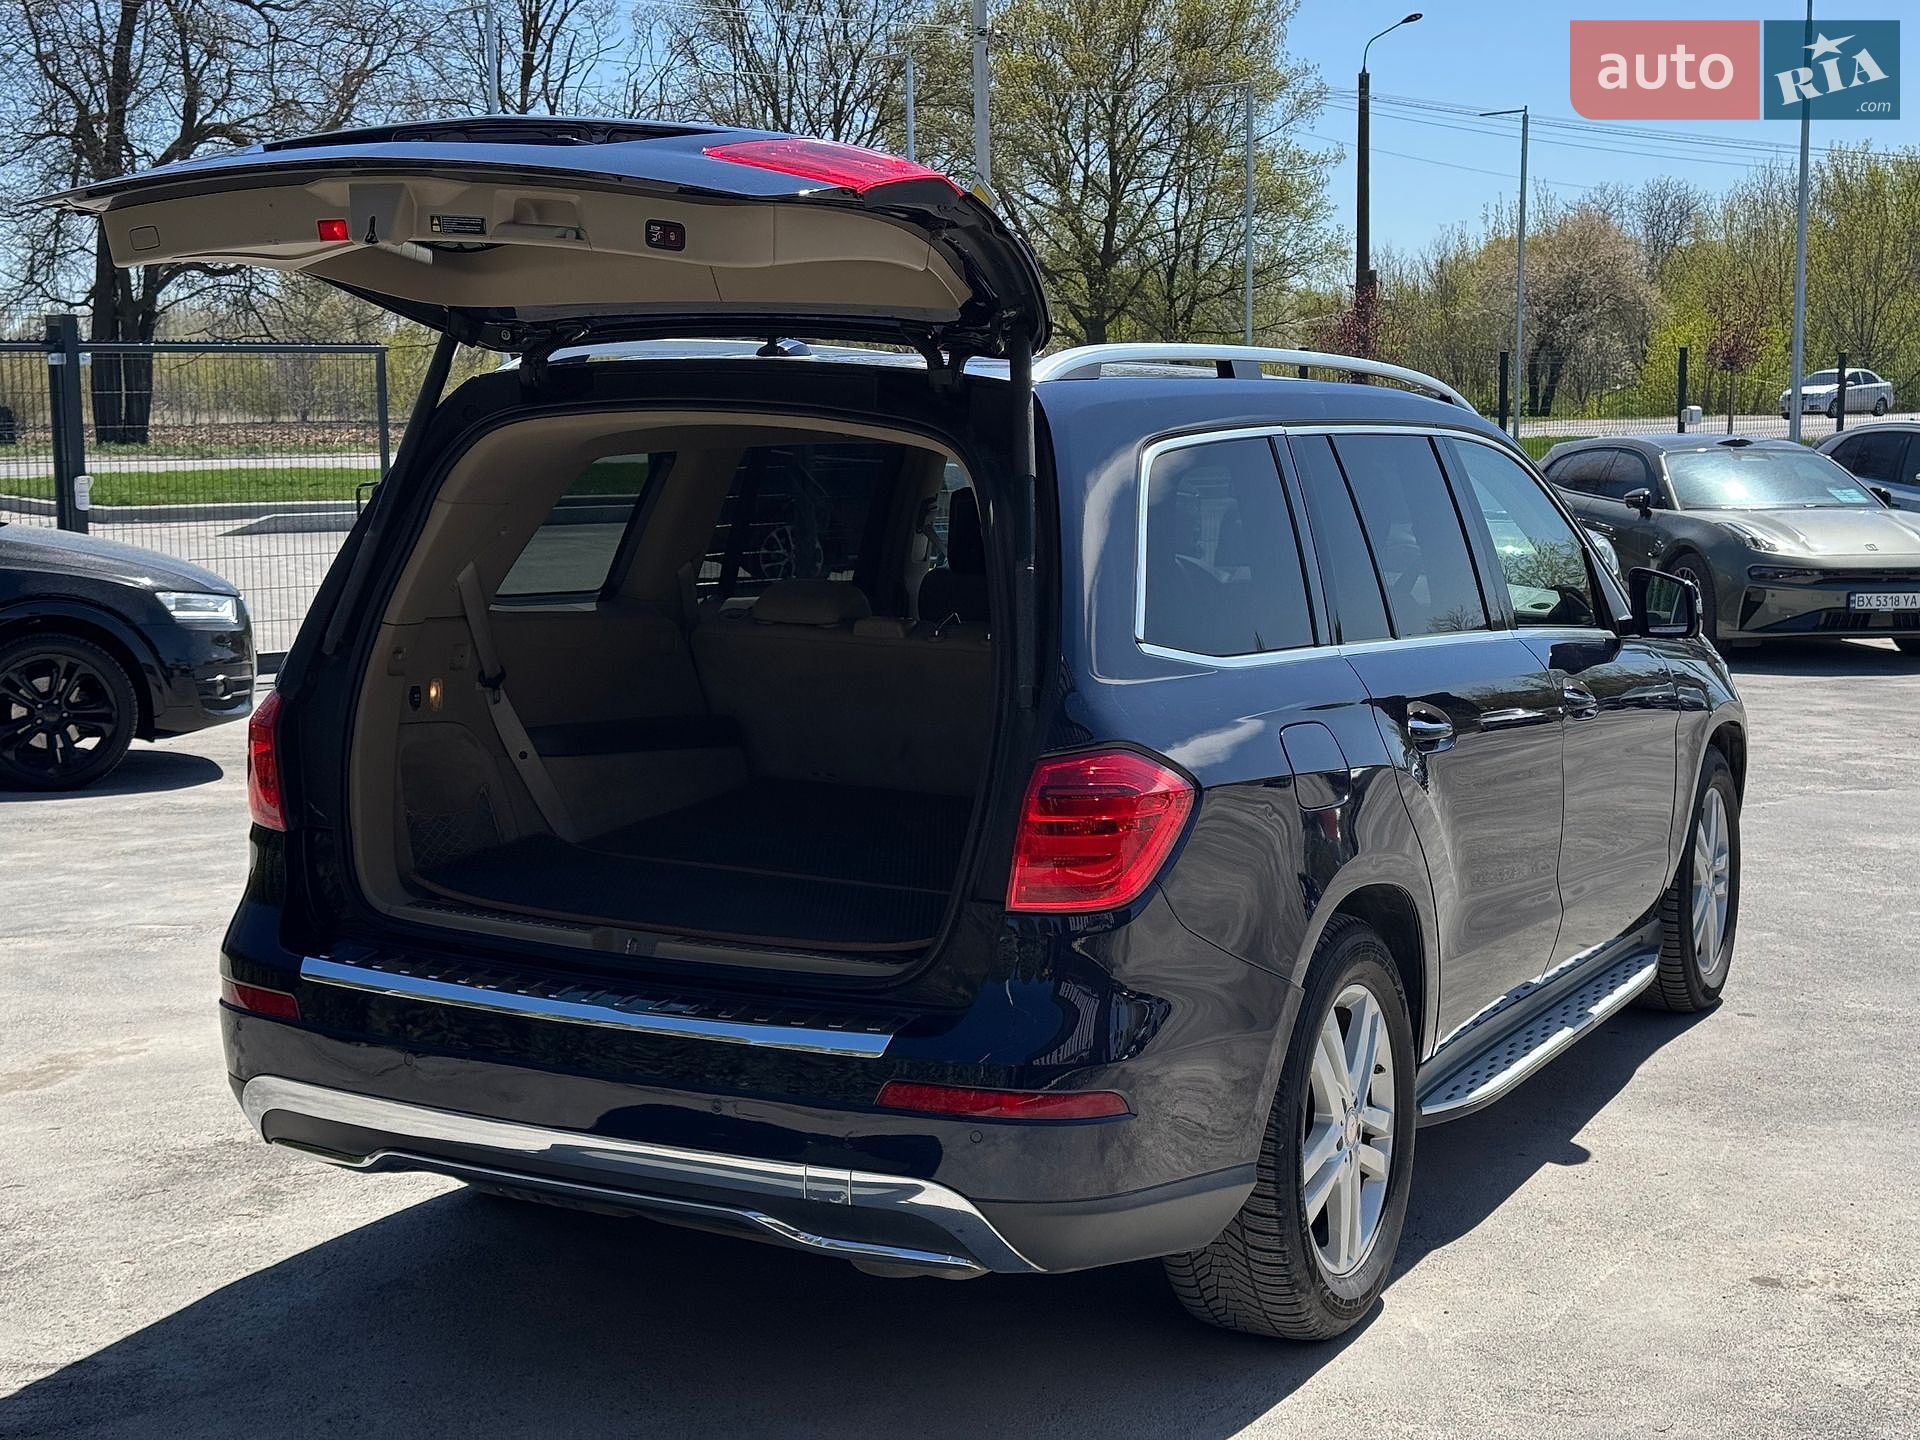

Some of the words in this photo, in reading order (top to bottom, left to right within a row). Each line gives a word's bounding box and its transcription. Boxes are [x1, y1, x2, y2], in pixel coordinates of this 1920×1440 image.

[1857, 595, 1873, 607] BX
[1875, 595, 1900, 607] 5318
[1903, 595, 1917, 607] YA
